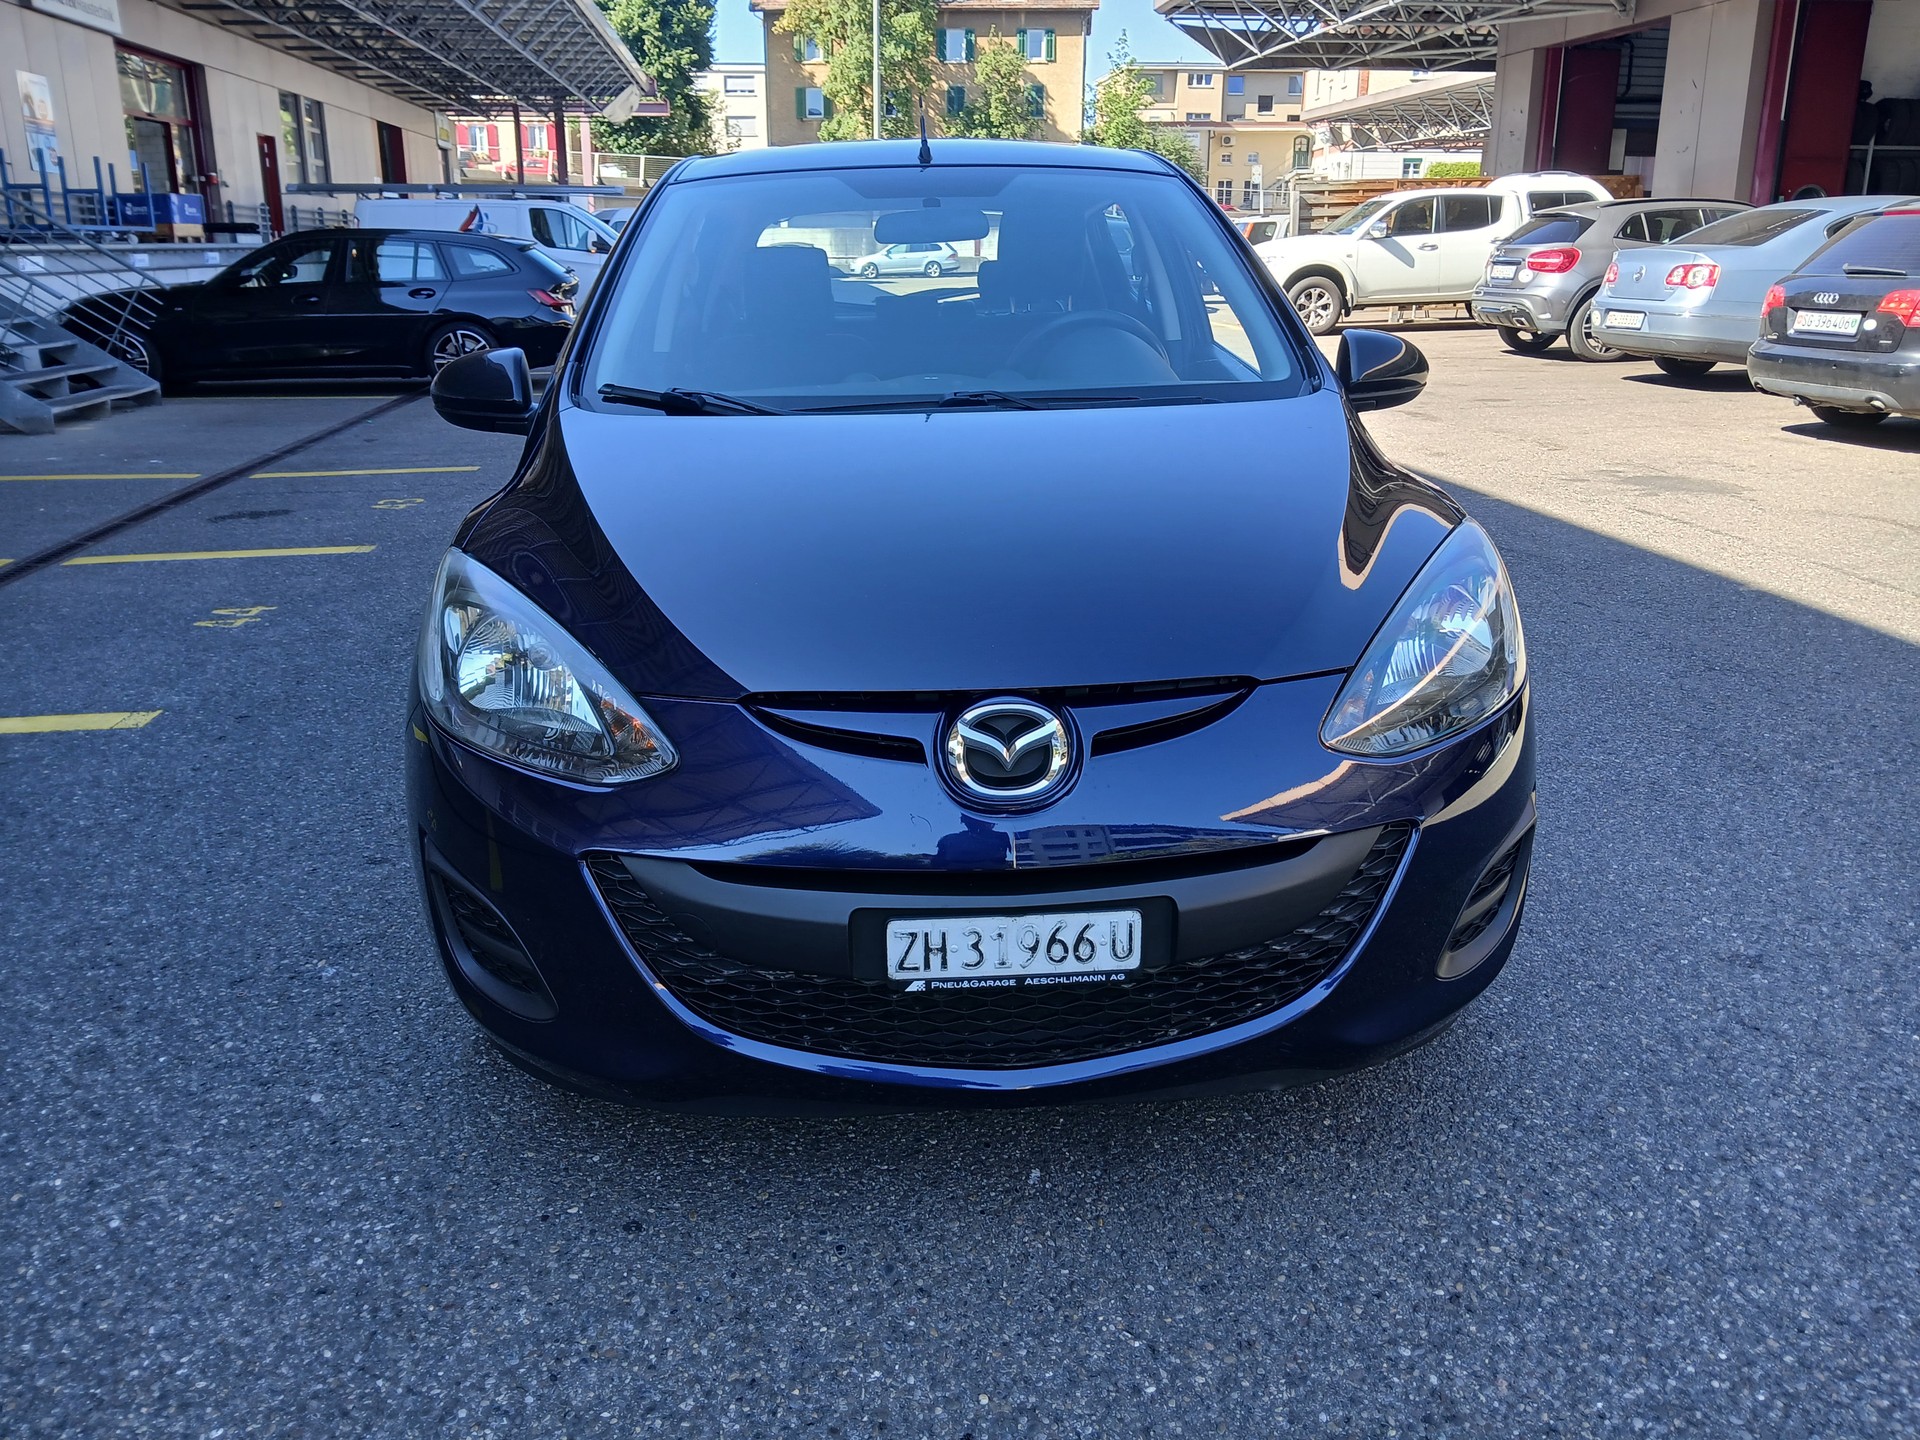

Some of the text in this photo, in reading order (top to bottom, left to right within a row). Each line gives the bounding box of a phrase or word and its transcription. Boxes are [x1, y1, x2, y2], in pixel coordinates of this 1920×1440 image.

[894, 918, 1136, 973] ZH 31966 U
[1110, 973, 1126, 981] AG
